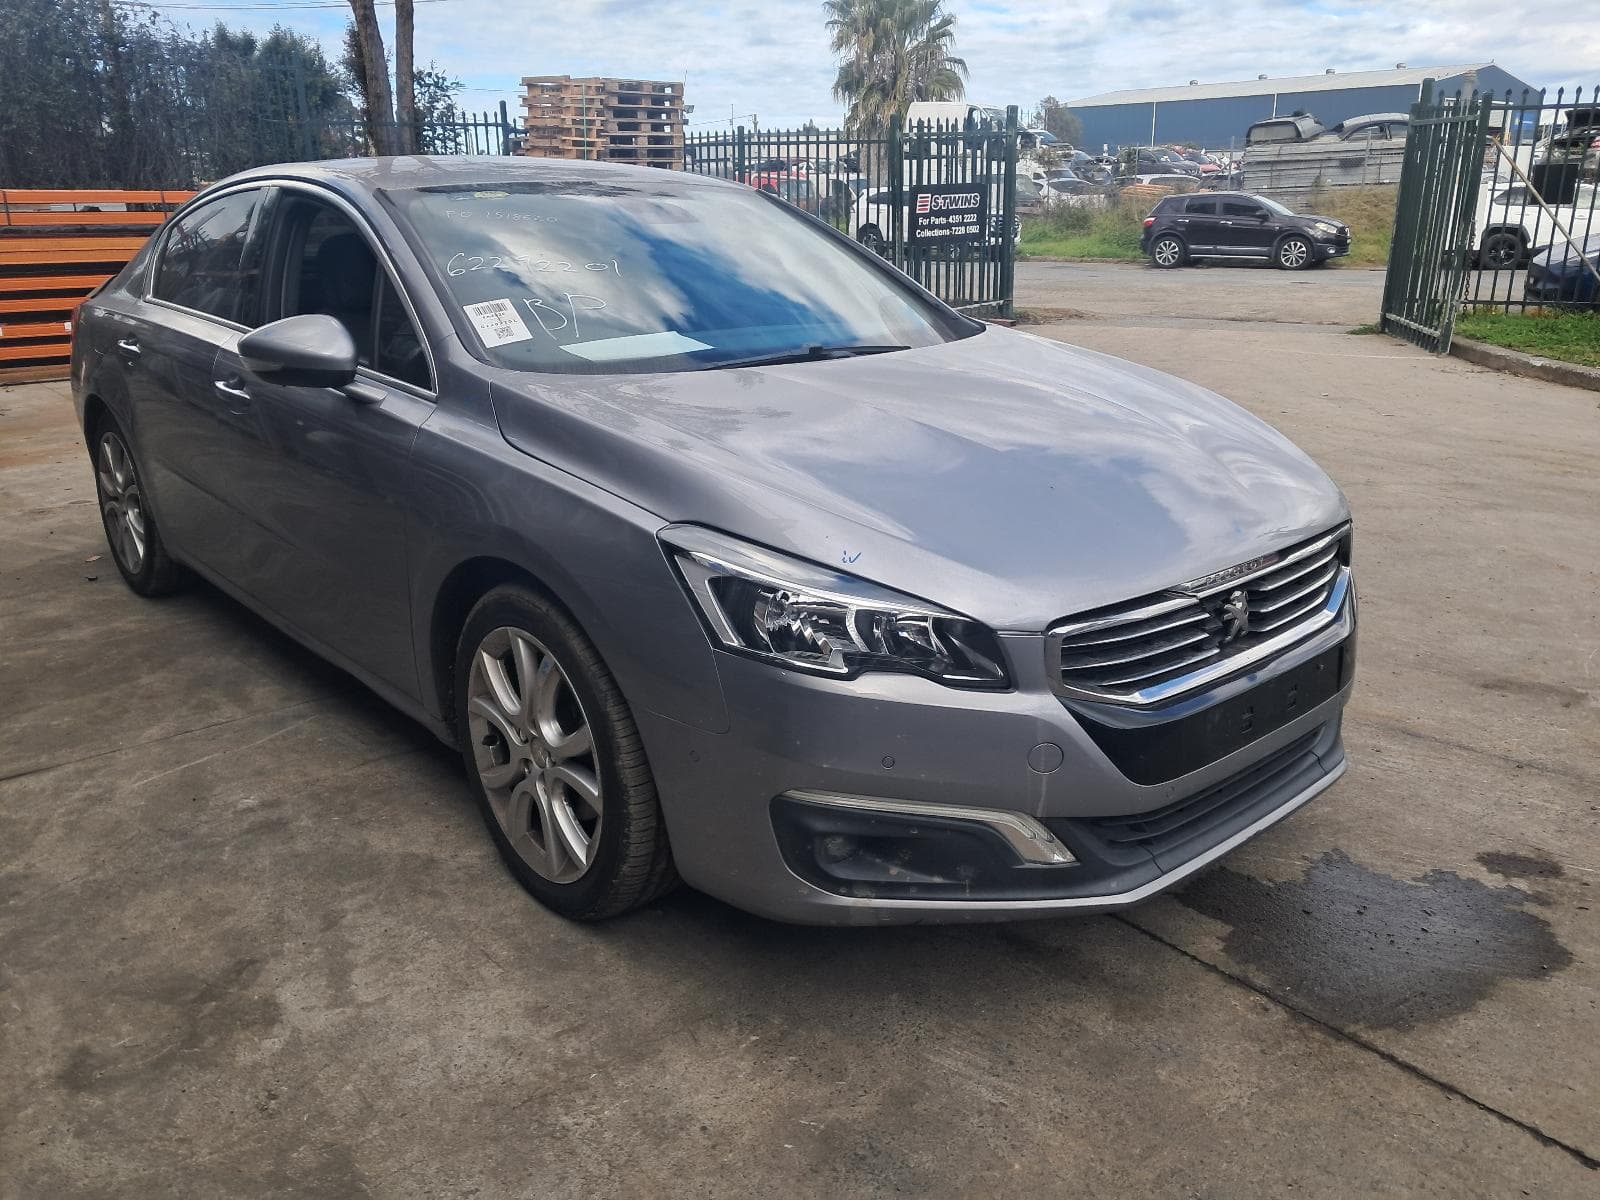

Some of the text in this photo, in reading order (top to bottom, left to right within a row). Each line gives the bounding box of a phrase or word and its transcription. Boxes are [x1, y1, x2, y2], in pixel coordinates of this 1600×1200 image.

[918, 217, 930, 226] For
[963, 213, 977, 223] 2222
[523, 292, 607, 341] BP
